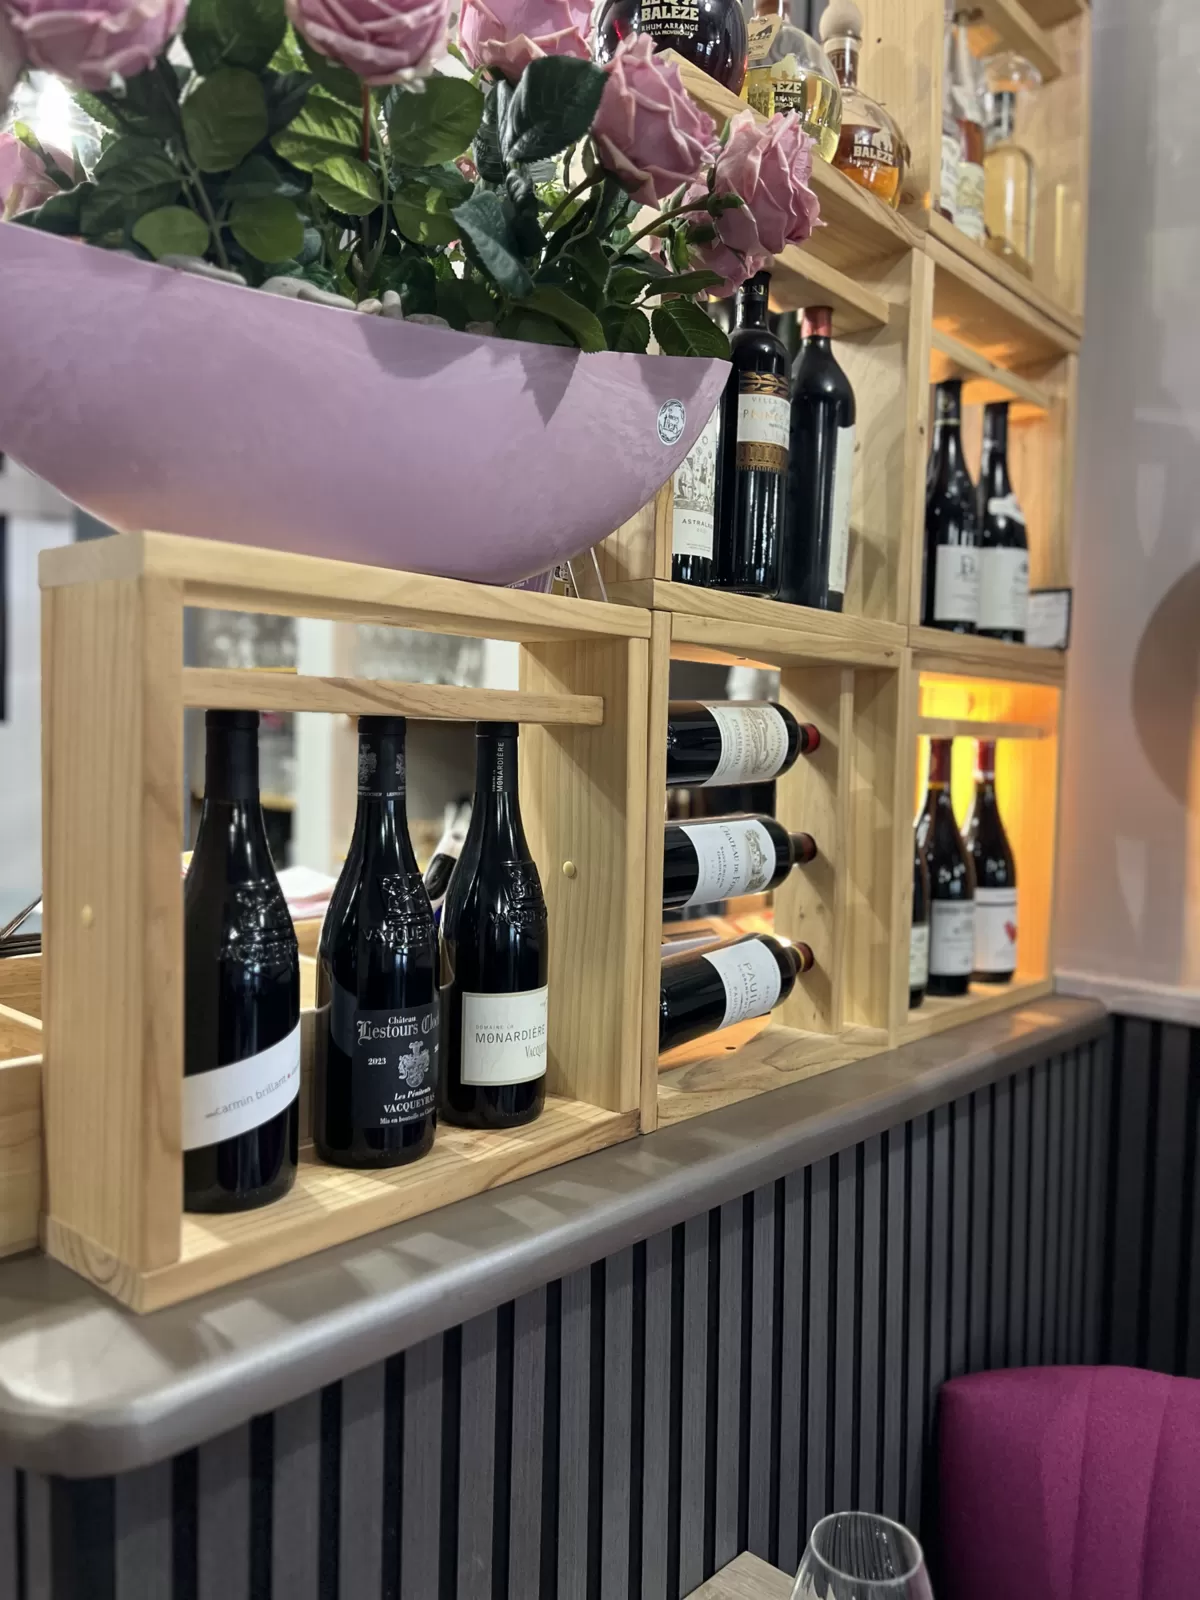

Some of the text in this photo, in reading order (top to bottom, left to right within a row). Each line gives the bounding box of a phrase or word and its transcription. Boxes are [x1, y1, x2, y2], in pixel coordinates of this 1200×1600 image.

[641, 6, 699, 21] BALEZE
[641, 23, 662, 32] RHUM
[854, 145, 894, 166] BALEZE
[496, 742, 505, 792] MONARDIÈRE
[388, 1016, 416, 1025] Château
[357, 1021, 418, 1045] Lestours
[475, 1023, 545, 1044] MONARDIÈRE
[214, 1074, 287, 1116] carmin brillant
[394, 1093, 406, 1101] Les
